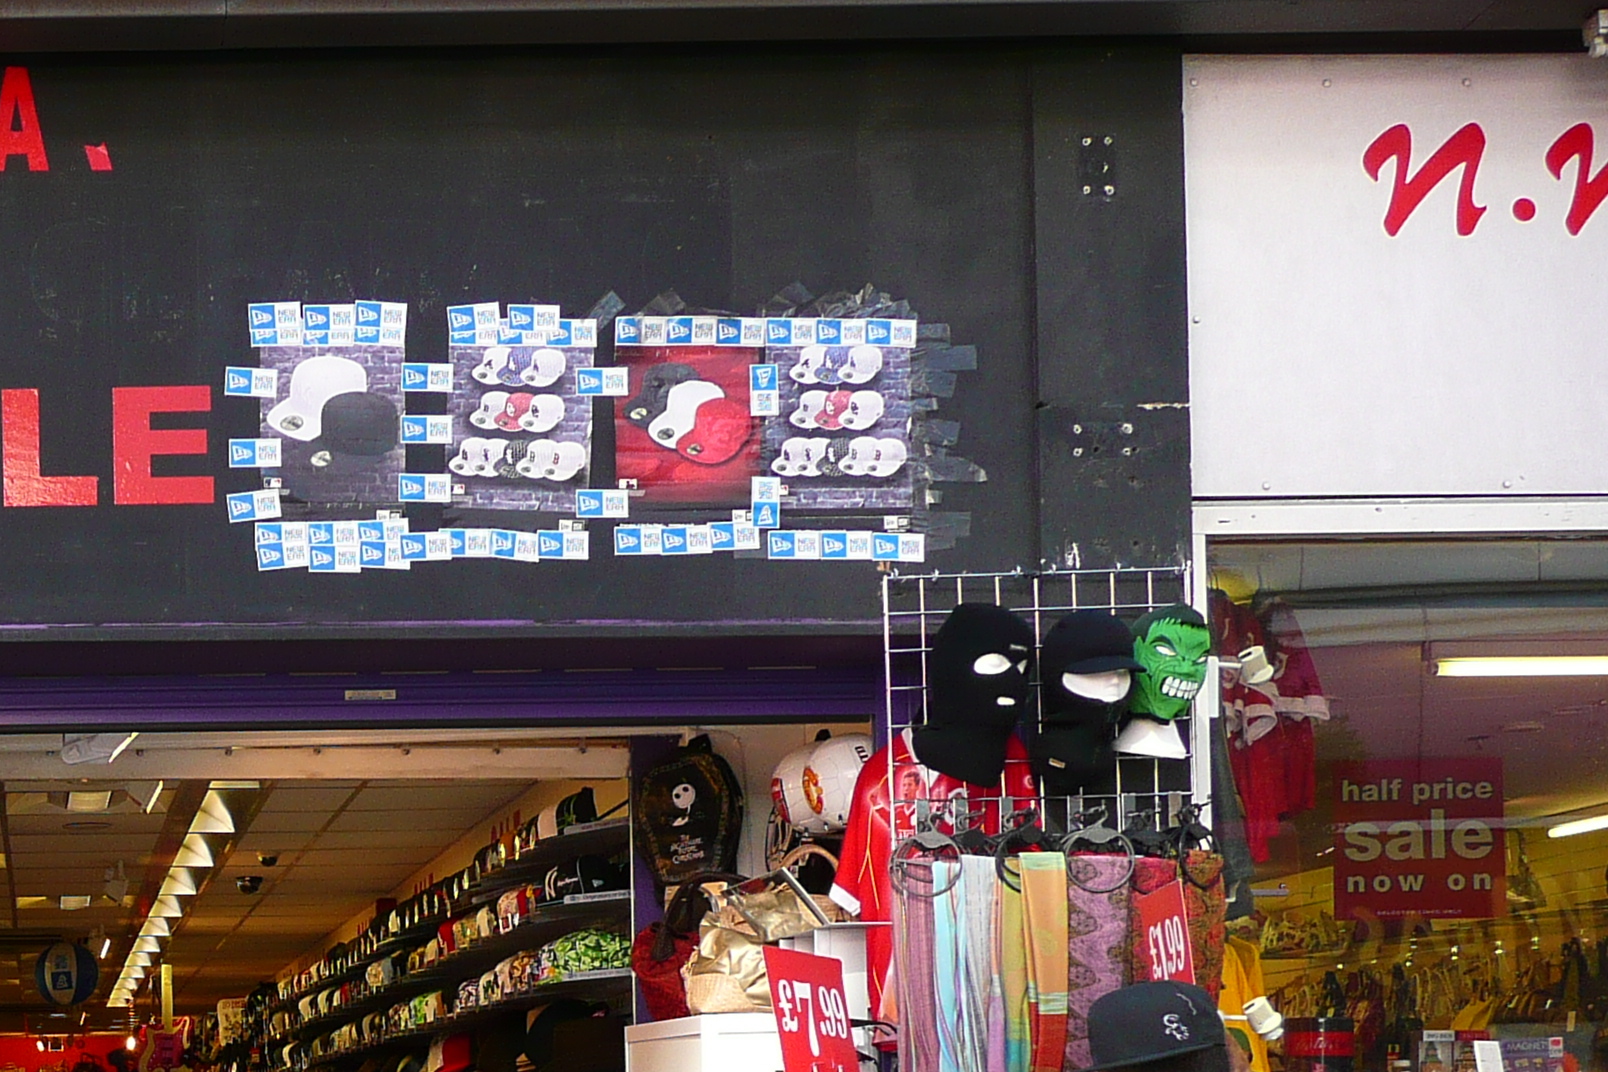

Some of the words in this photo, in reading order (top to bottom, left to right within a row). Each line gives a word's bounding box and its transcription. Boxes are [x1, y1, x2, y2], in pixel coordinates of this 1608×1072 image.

[1342, 778, 1402, 801] half
[1412, 777, 1493, 805] price
[1343, 808, 1493, 862] sale
[1346, 873, 1425, 893] now
[1446, 871, 1493, 891] on
[1148, 914, 1186, 980] £1.99
[777, 978, 848, 1057] £7.99
